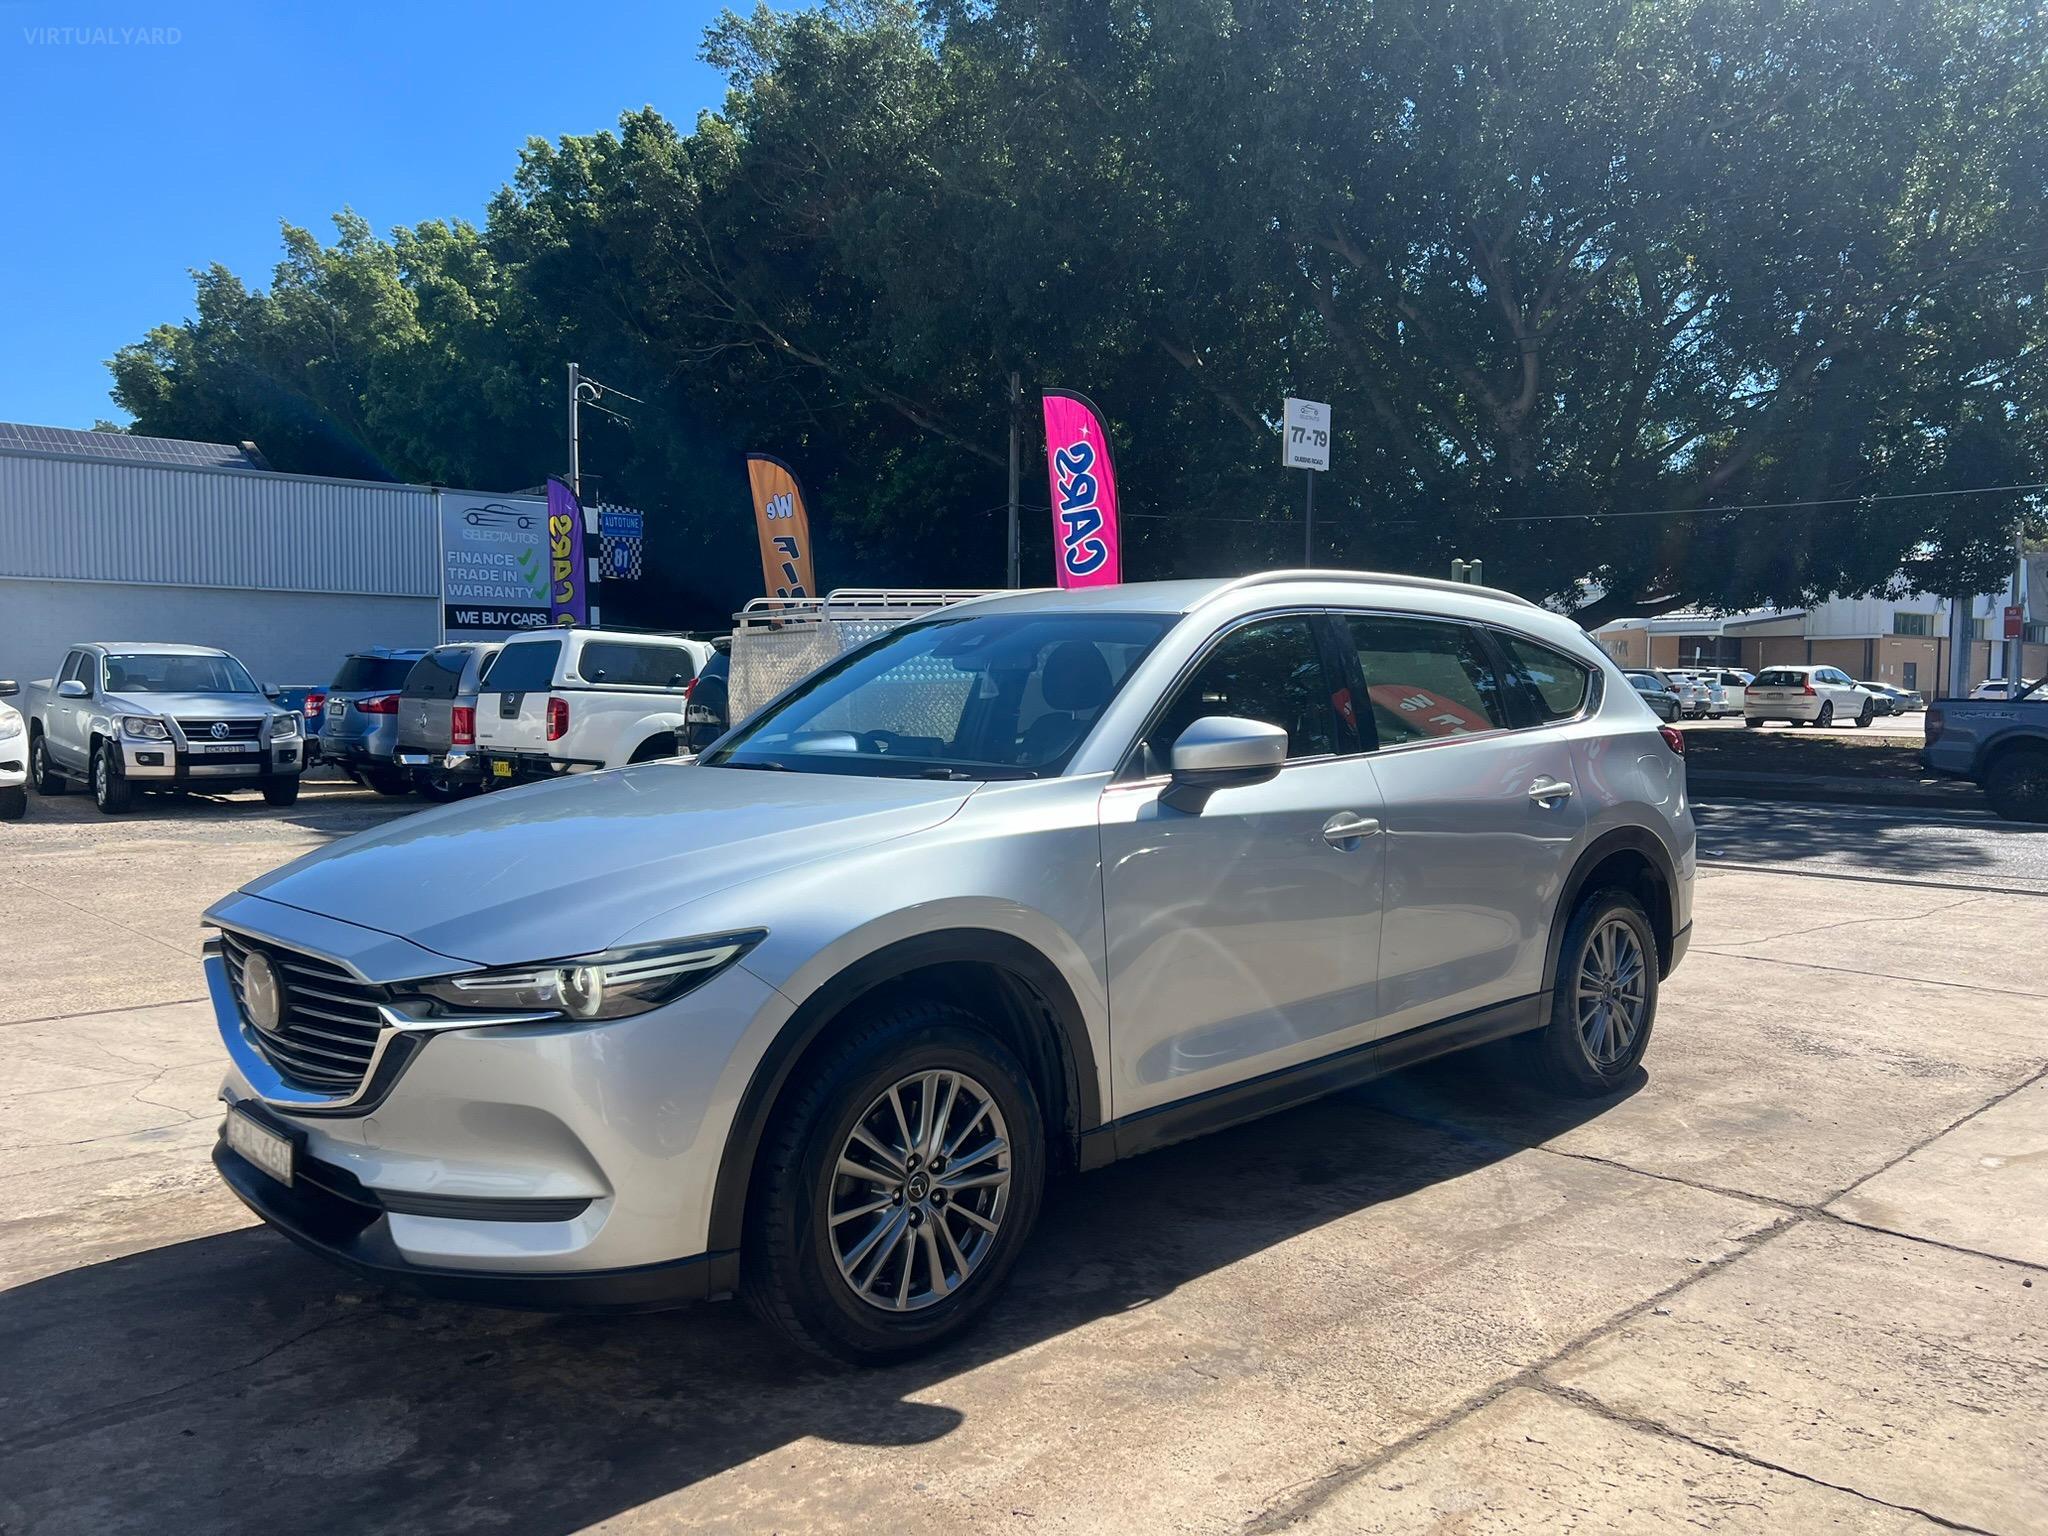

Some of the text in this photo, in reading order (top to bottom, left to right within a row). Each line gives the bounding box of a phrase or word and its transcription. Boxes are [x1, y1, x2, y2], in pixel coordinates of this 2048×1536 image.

[1291, 425, 1328, 448] 77-79
[605, 516, 640, 529] AUTOTUNE
[448, 551, 515, 566] FINANCE
[614, 548, 629, 569] 81
[448, 567, 518, 582] TRADE IN
[448, 584, 535, 599] WARRANTY
[455, 610, 480, 625] WE
[482, 611, 510, 625] BUY
[510, 612, 548, 626] CARS
